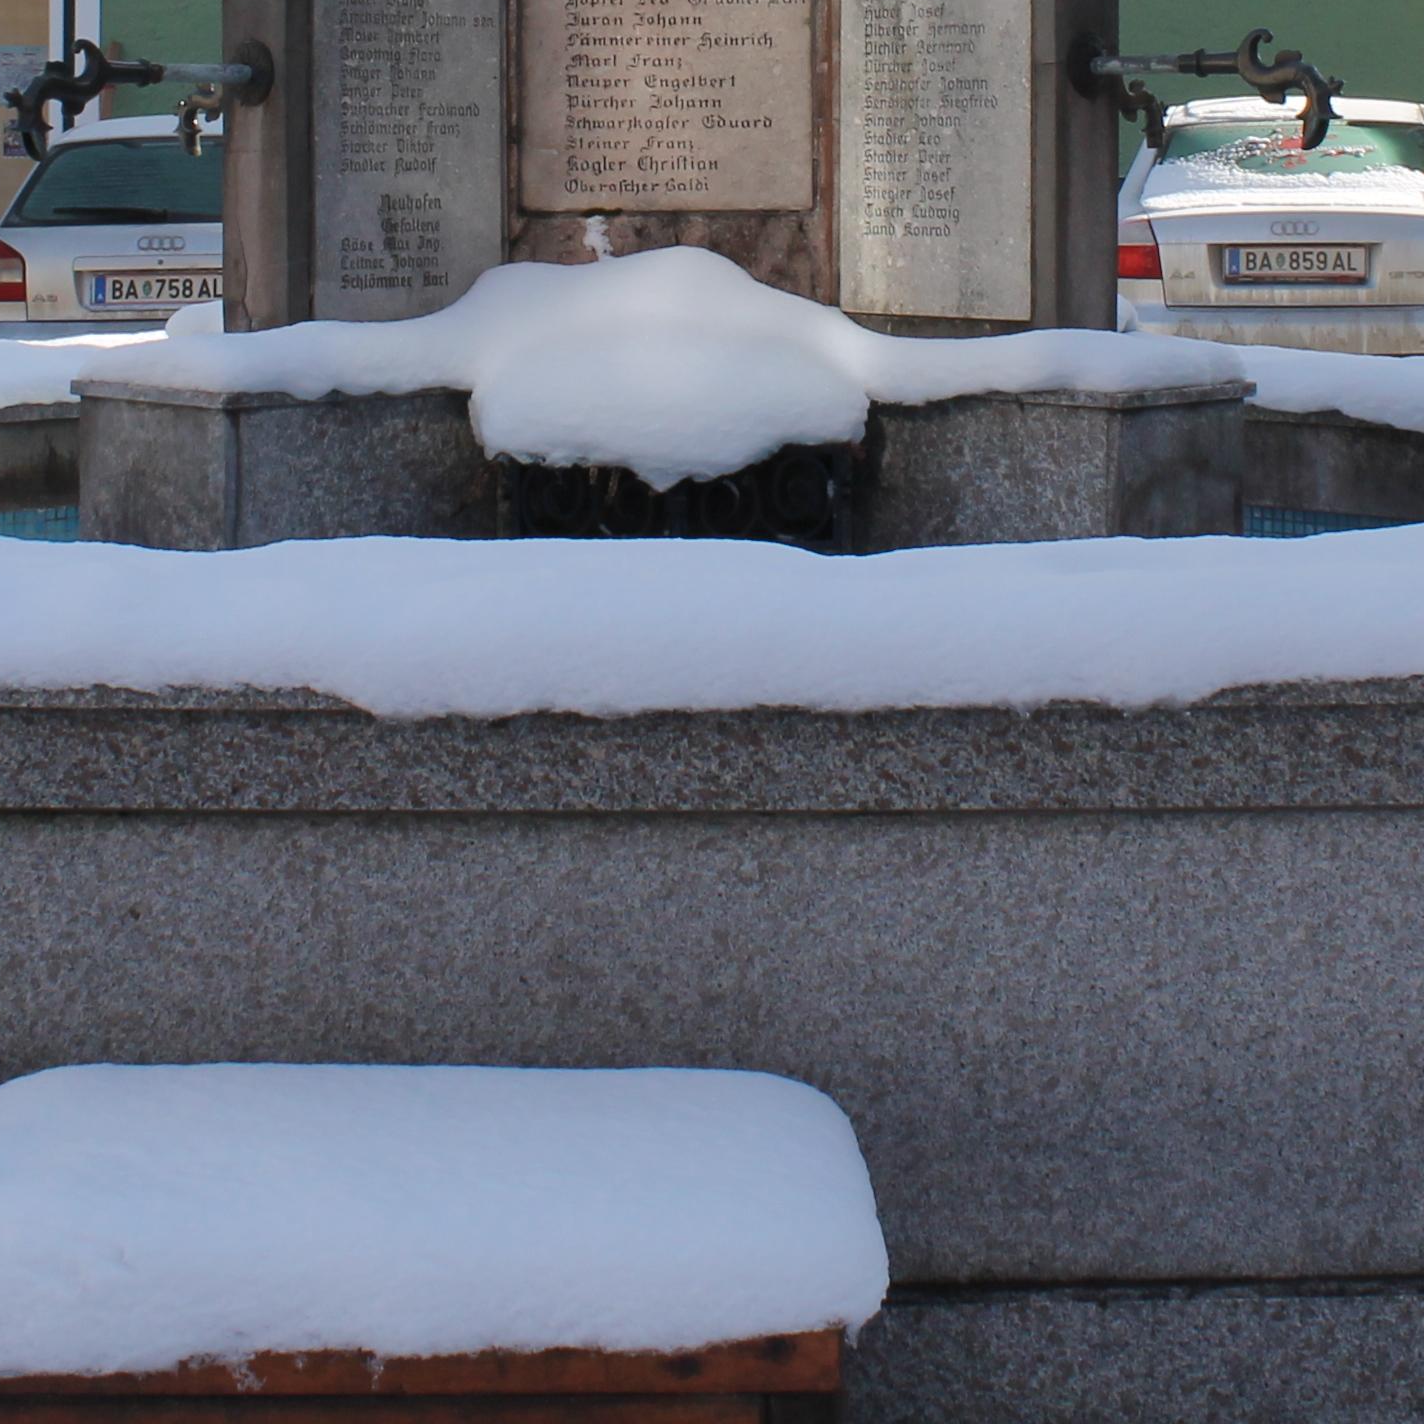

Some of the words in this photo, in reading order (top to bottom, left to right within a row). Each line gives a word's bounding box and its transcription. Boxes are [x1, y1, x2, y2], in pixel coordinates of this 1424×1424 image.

[421, 11, 466, 28] Johann
[632, 12, 703, 30] Johann
[926, 23, 986, 38] Hermann
[697, 32, 774, 51] Heinrich
[864, 40, 906, 56] Pichler
[627, 55, 684, 69] Franz
[390, 64, 436, 80] Johann
[565, 75, 631, 89] Neuper
[644, 75, 736, 91] Engelbert
[940, 77, 988, 95] Johann
[566, 95, 638, 111] Pürcher
[650, 94, 723, 110] Johann
[940, 95, 999, 113] Siegfried
[418, 103, 480, 121] Ferdinand
[701, 114, 773, 128] Eduard
[864, 114, 905, 129] Singer
[914, 114, 961, 129] Johann
[427, 122, 461, 139] Franz
[864, 130, 909, 145] Stadler
[919, 132, 941, 145] Leo
[397, 139, 436, 154] Viktor
[566, 136, 631, 151] Steiner
[566, 155, 627, 175] Kogler
[637, 154, 719, 174] Christian
[864, 149, 909, 164] Stadler
[919, 150, 951, 165] Peter
[340, 158, 386, 174] Stadler
[394, 158, 438, 177] Rudolf
[864, 168, 908, 182] Steiner
[916, 168, 952, 185] Josef
[864, 186, 912, 204] Stiegler
[920, 187, 956, 203] Josef
[378, 194, 443, 215] Neuhofen
[912, 203, 960, 225] Ludwig
[381, 218, 441, 233] Gefallene
[903, 224, 951, 237] Konrad
[392, 255, 439, 273] Johann
[1246, 252, 1272, 271] BA
[1289, 252, 1326, 271] 859
[1333, 252, 1357, 271] AL
[112, 280, 138, 299] BA
[156, 279, 193, 298] 758
[198, 279, 223, 298] AL
[340, 275, 413, 291] Schlömmer
[422, 272, 449, 288] Karl
